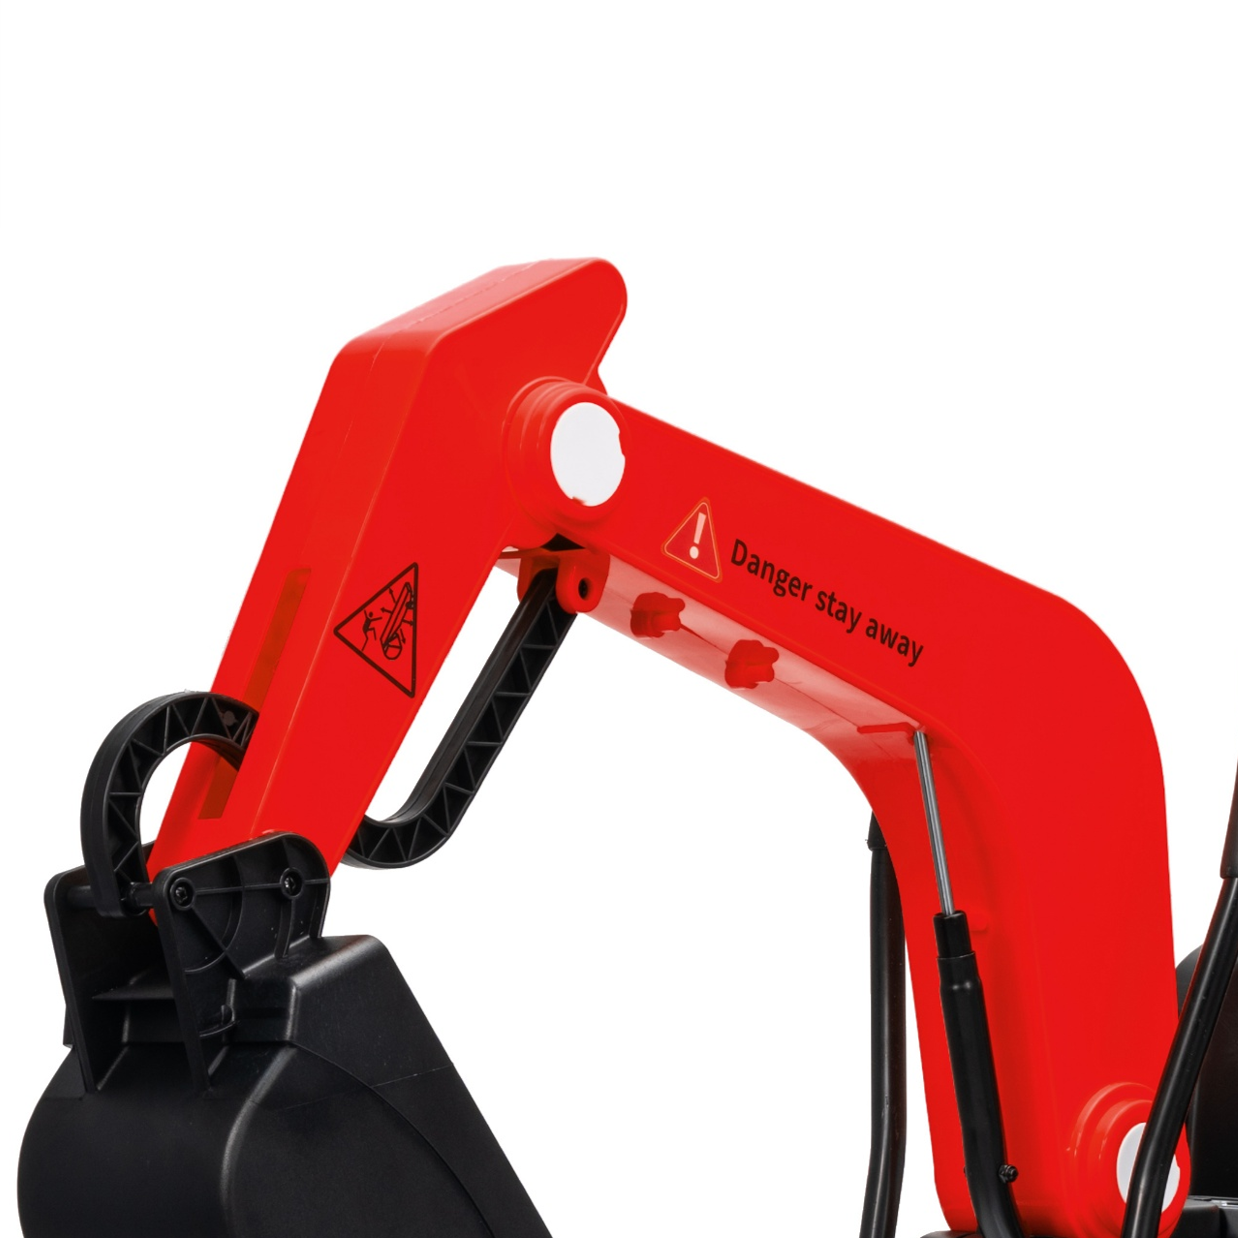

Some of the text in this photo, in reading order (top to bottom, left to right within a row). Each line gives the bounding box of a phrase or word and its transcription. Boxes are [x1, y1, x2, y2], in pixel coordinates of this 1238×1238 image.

[730, 538, 924, 667] Danger stay away
